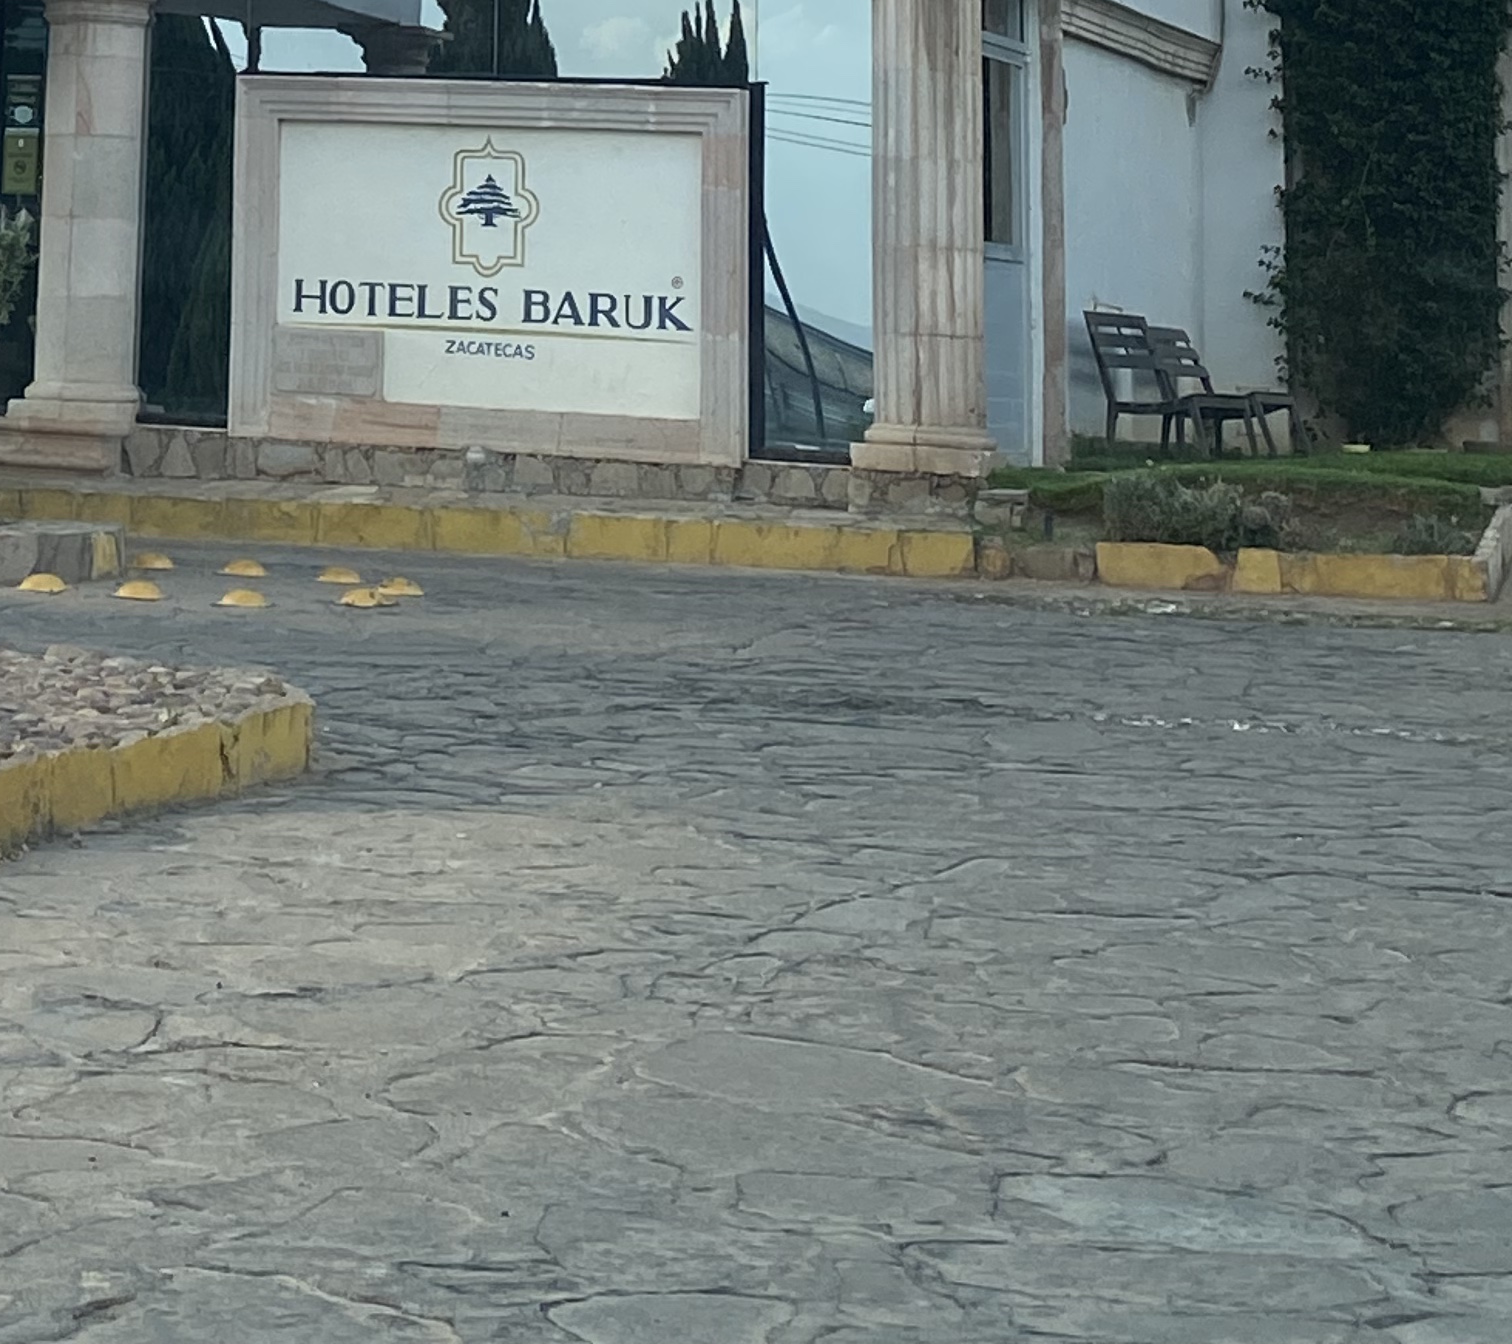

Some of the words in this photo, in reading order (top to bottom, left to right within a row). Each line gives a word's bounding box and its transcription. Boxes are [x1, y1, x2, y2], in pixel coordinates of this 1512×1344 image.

[292, 278, 499, 322] HOTELES
[521, 288, 694, 332] BARUK
[444, 339, 536, 361] ZACATECAS
